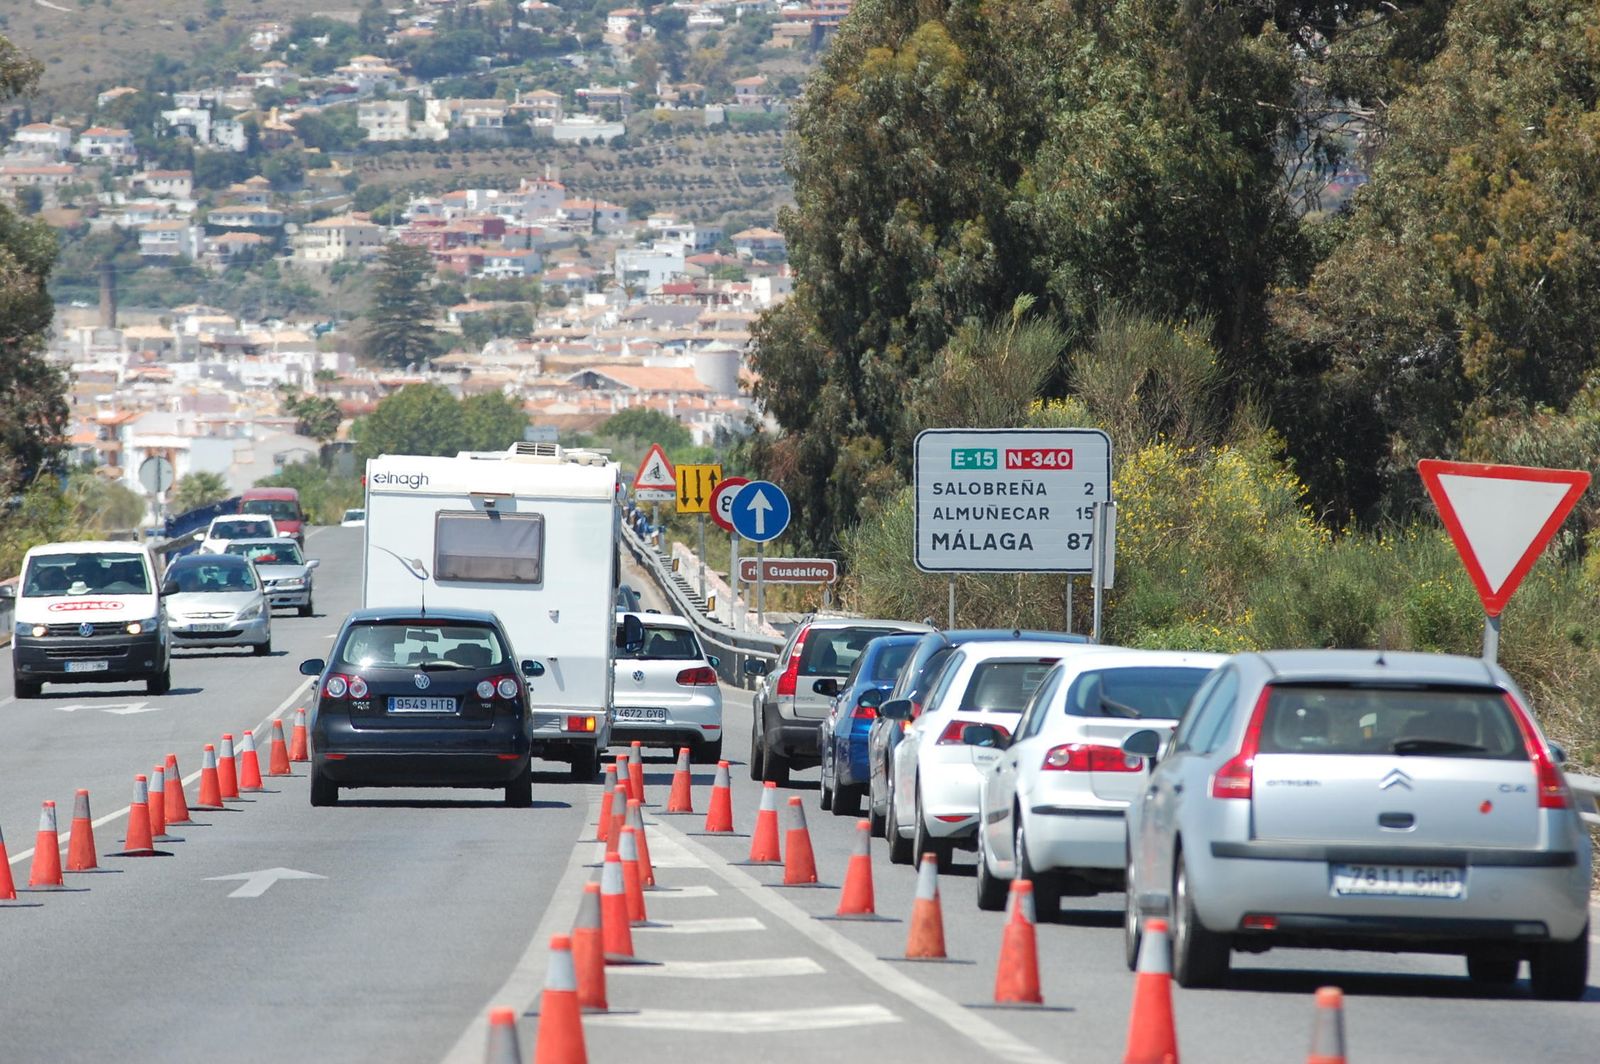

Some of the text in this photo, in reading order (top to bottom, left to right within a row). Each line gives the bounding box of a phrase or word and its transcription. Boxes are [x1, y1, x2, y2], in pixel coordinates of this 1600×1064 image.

[954, 451, 1071, 467] E-15 N-340
[373, 470, 429, 489] elnagh
[932, 479, 1095, 496] SALOBREÑA 2
[721, 495, 732, 513] 8
[932, 504, 1094, 520] ALMUÑECAR 15
[931, 529, 1094, 551] MÁLAGA 87
[769, 566, 829, 577] Guadalfeo
[396, 699, 454, 712] 9549 HTB
[619, 709, 642, 718] 4672
